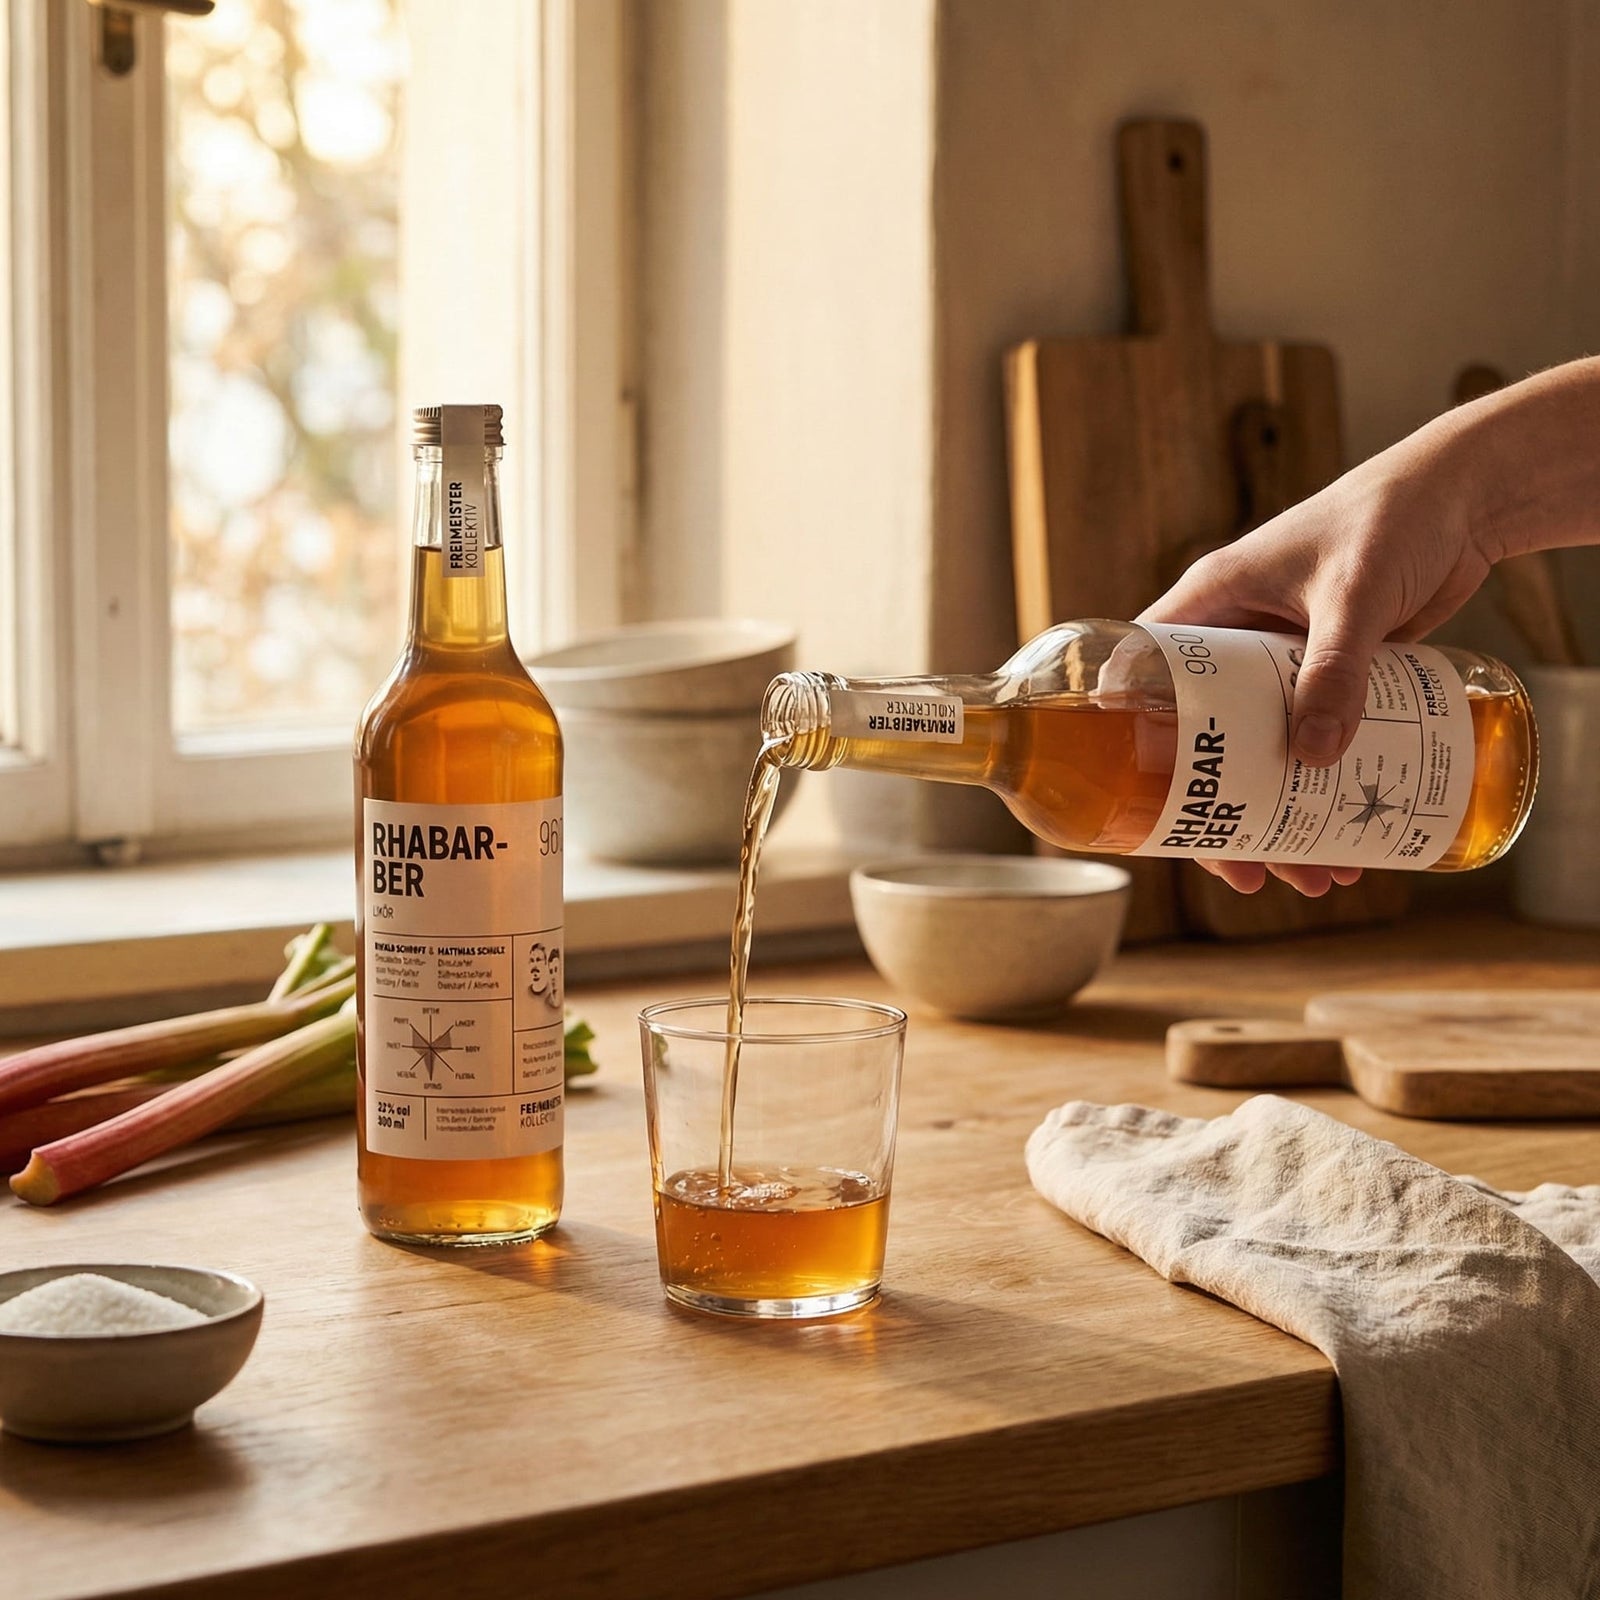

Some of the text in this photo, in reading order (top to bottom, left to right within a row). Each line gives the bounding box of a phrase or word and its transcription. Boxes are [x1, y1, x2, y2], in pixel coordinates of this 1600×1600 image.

[449, 482, 462, 569] FREIMEISTER
[465, 504, 478, 568] KOLLEKTIV
[1169, 633, 1218, 675] 960
[1160, 716, 1225, 847] RHABAR-
[373, 822, 508, 860] RHABAR-
[1193, 803, 1247, 849] BER
[373, 860, 425, 897] BER
